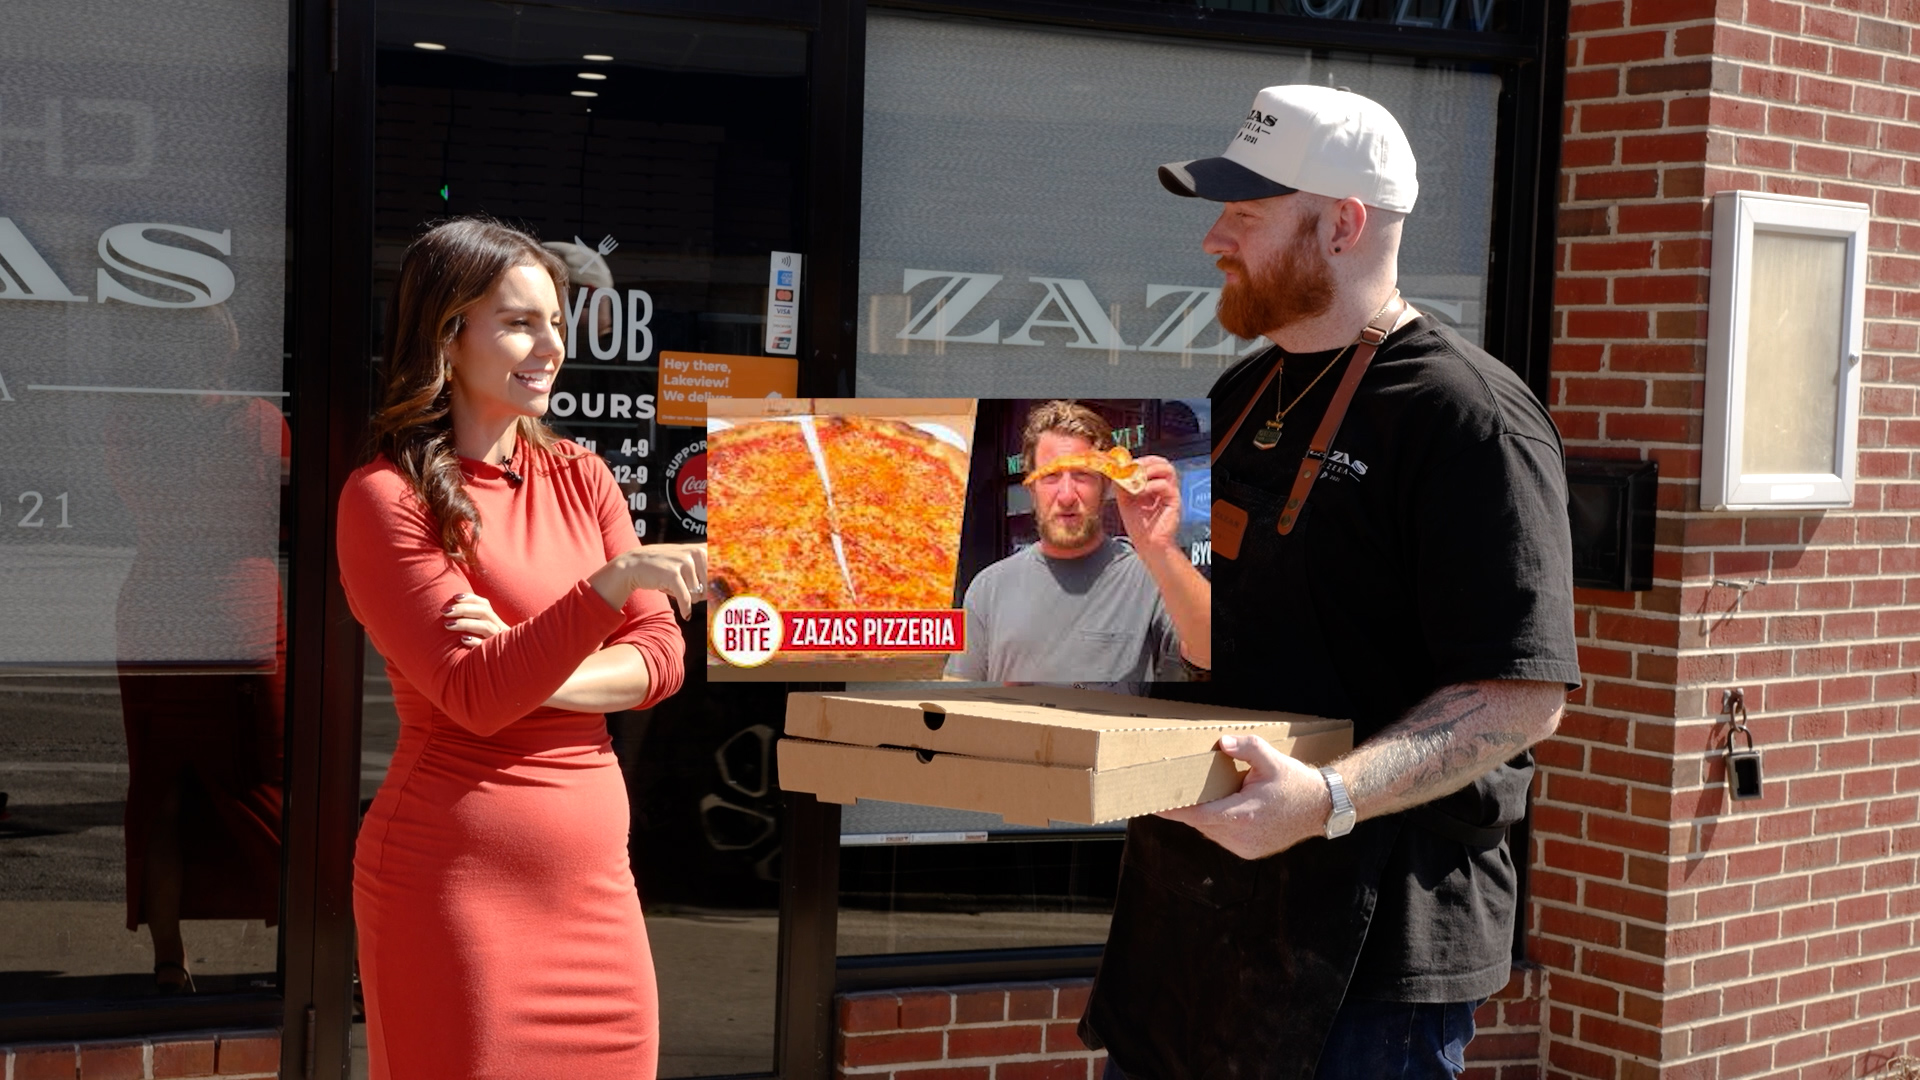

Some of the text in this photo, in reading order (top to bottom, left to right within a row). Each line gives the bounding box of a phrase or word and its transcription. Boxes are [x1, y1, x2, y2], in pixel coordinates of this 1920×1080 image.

[0, 217, 235, 309] AS
[896, 268, 1462, 357] ZAZ
[563, 286, 653, 361] YOB
[664, 358, 732, 374] Hey there,
[663, 374, 729, 388] Lakeview!
[550, 391, 656, 419] OURS
[663, 390, 685, 402] We
[620, 438, 649, 457] 4-9
[665, 440, 708, 479] SUPPOR
[612, 465, 648, 484] 12-9
[0, 490, 73, 528] 21
[627, 492, 647, 511] 10
[634, 519, 647, 537] 9
[681, 518, 708, 535] CHI
